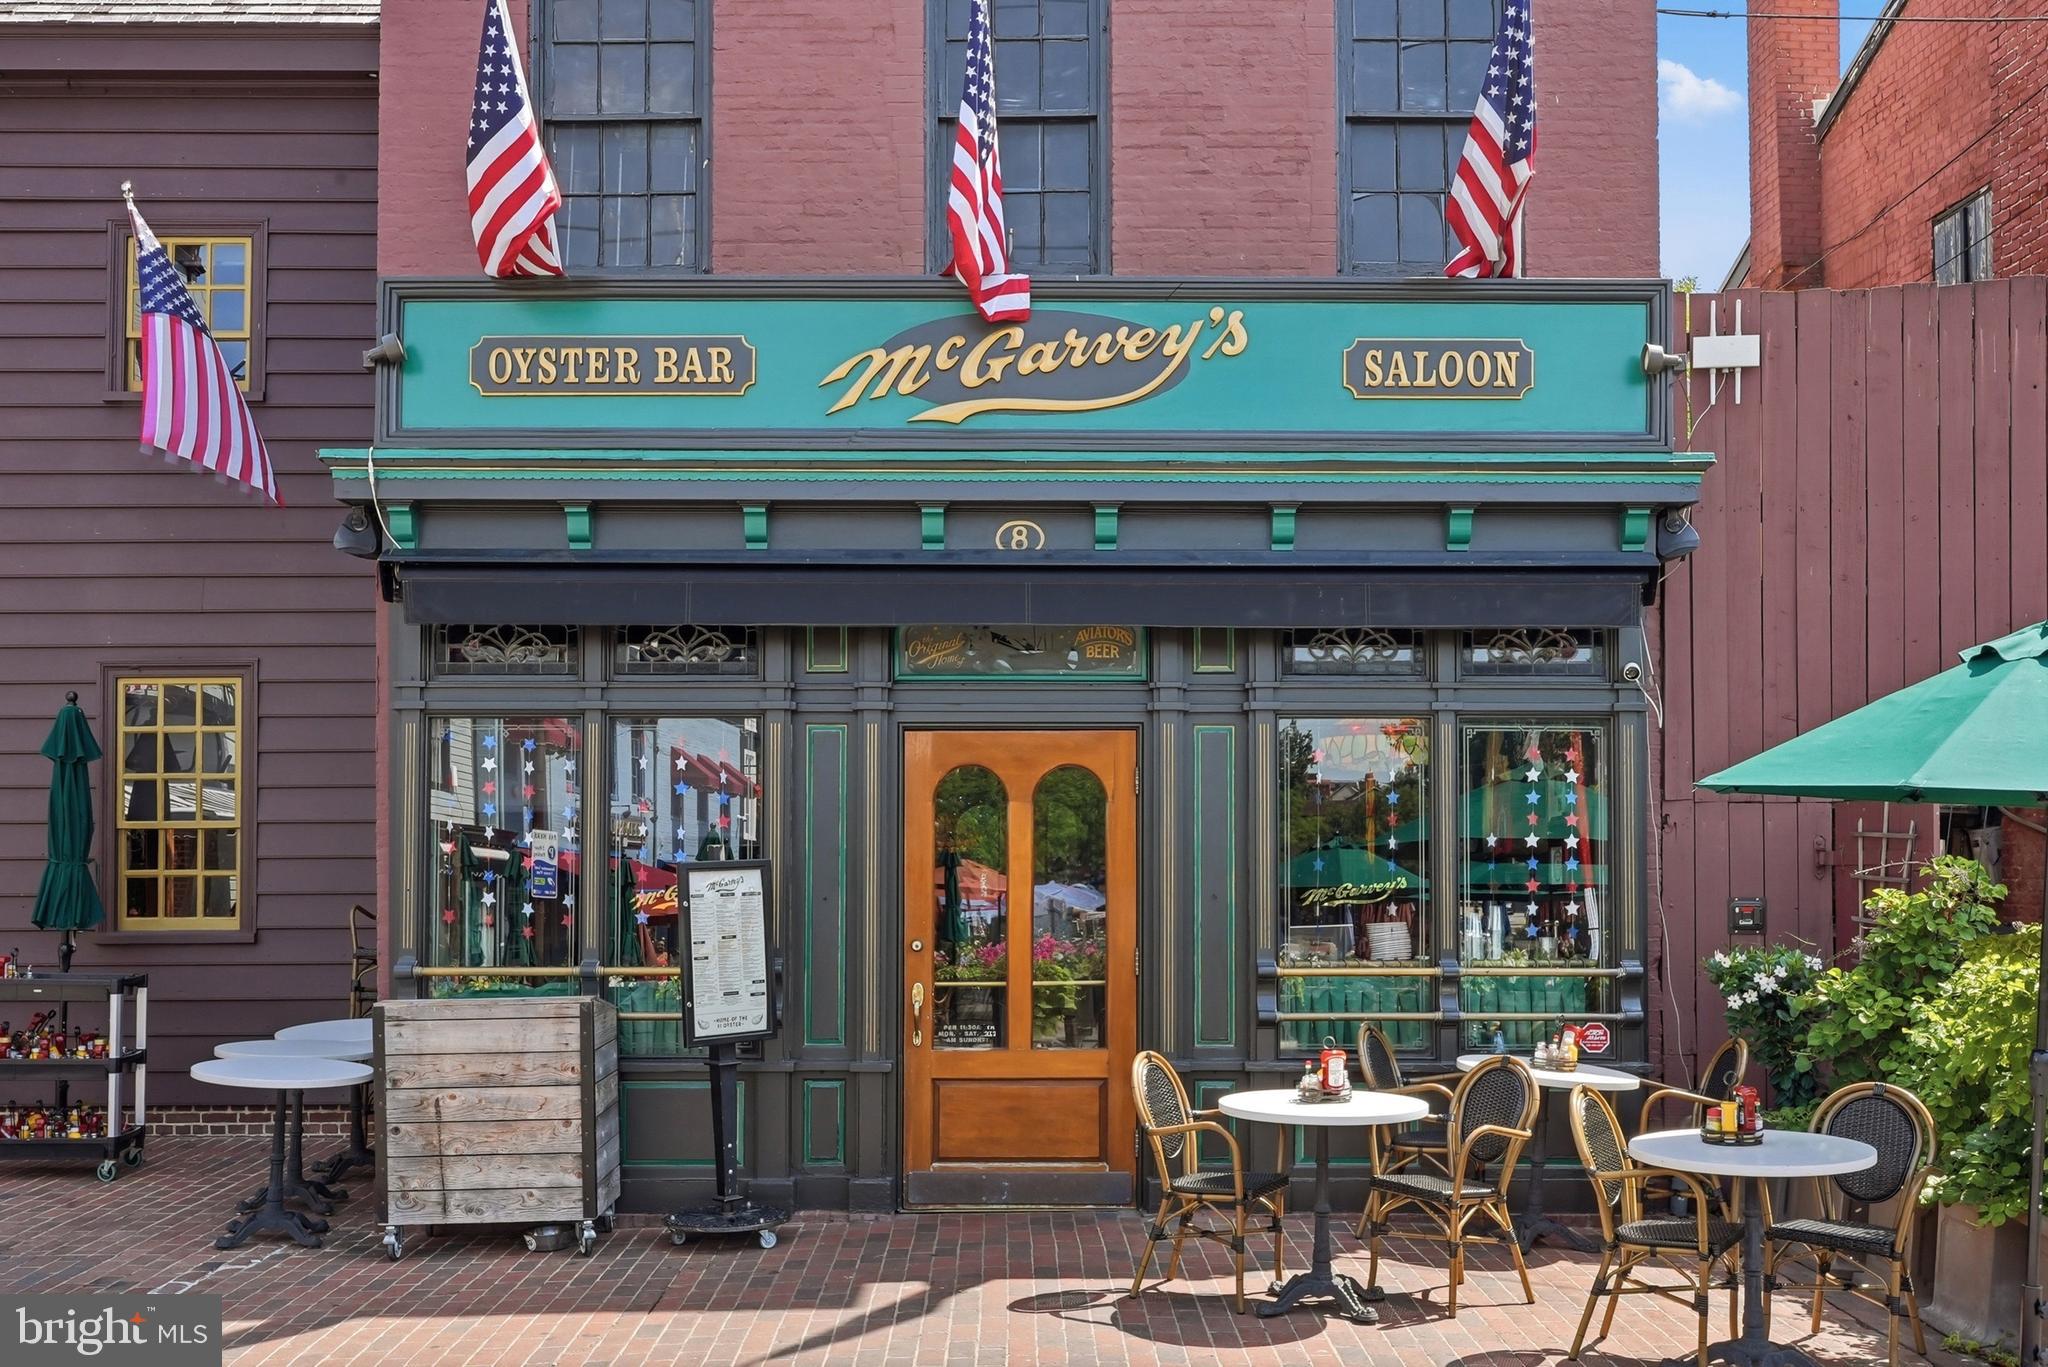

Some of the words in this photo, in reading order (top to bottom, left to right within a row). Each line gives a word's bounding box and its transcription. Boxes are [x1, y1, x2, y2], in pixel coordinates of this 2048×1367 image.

[488, 347, 641, 384] OYSTER
[653, 347, 735, 384] BAR
[818, 306, 1249, 424] McGarvey's
[1364, 349, 1520, 387] SALOON
[1011, 525, 1029, 550] 8
[908, 632, 962, 658] Original
[1086, 644, 1119, 659] BEER
[928, 654, 961, 670] Home
[1299, 876, 1408, 906] McGarvey's
